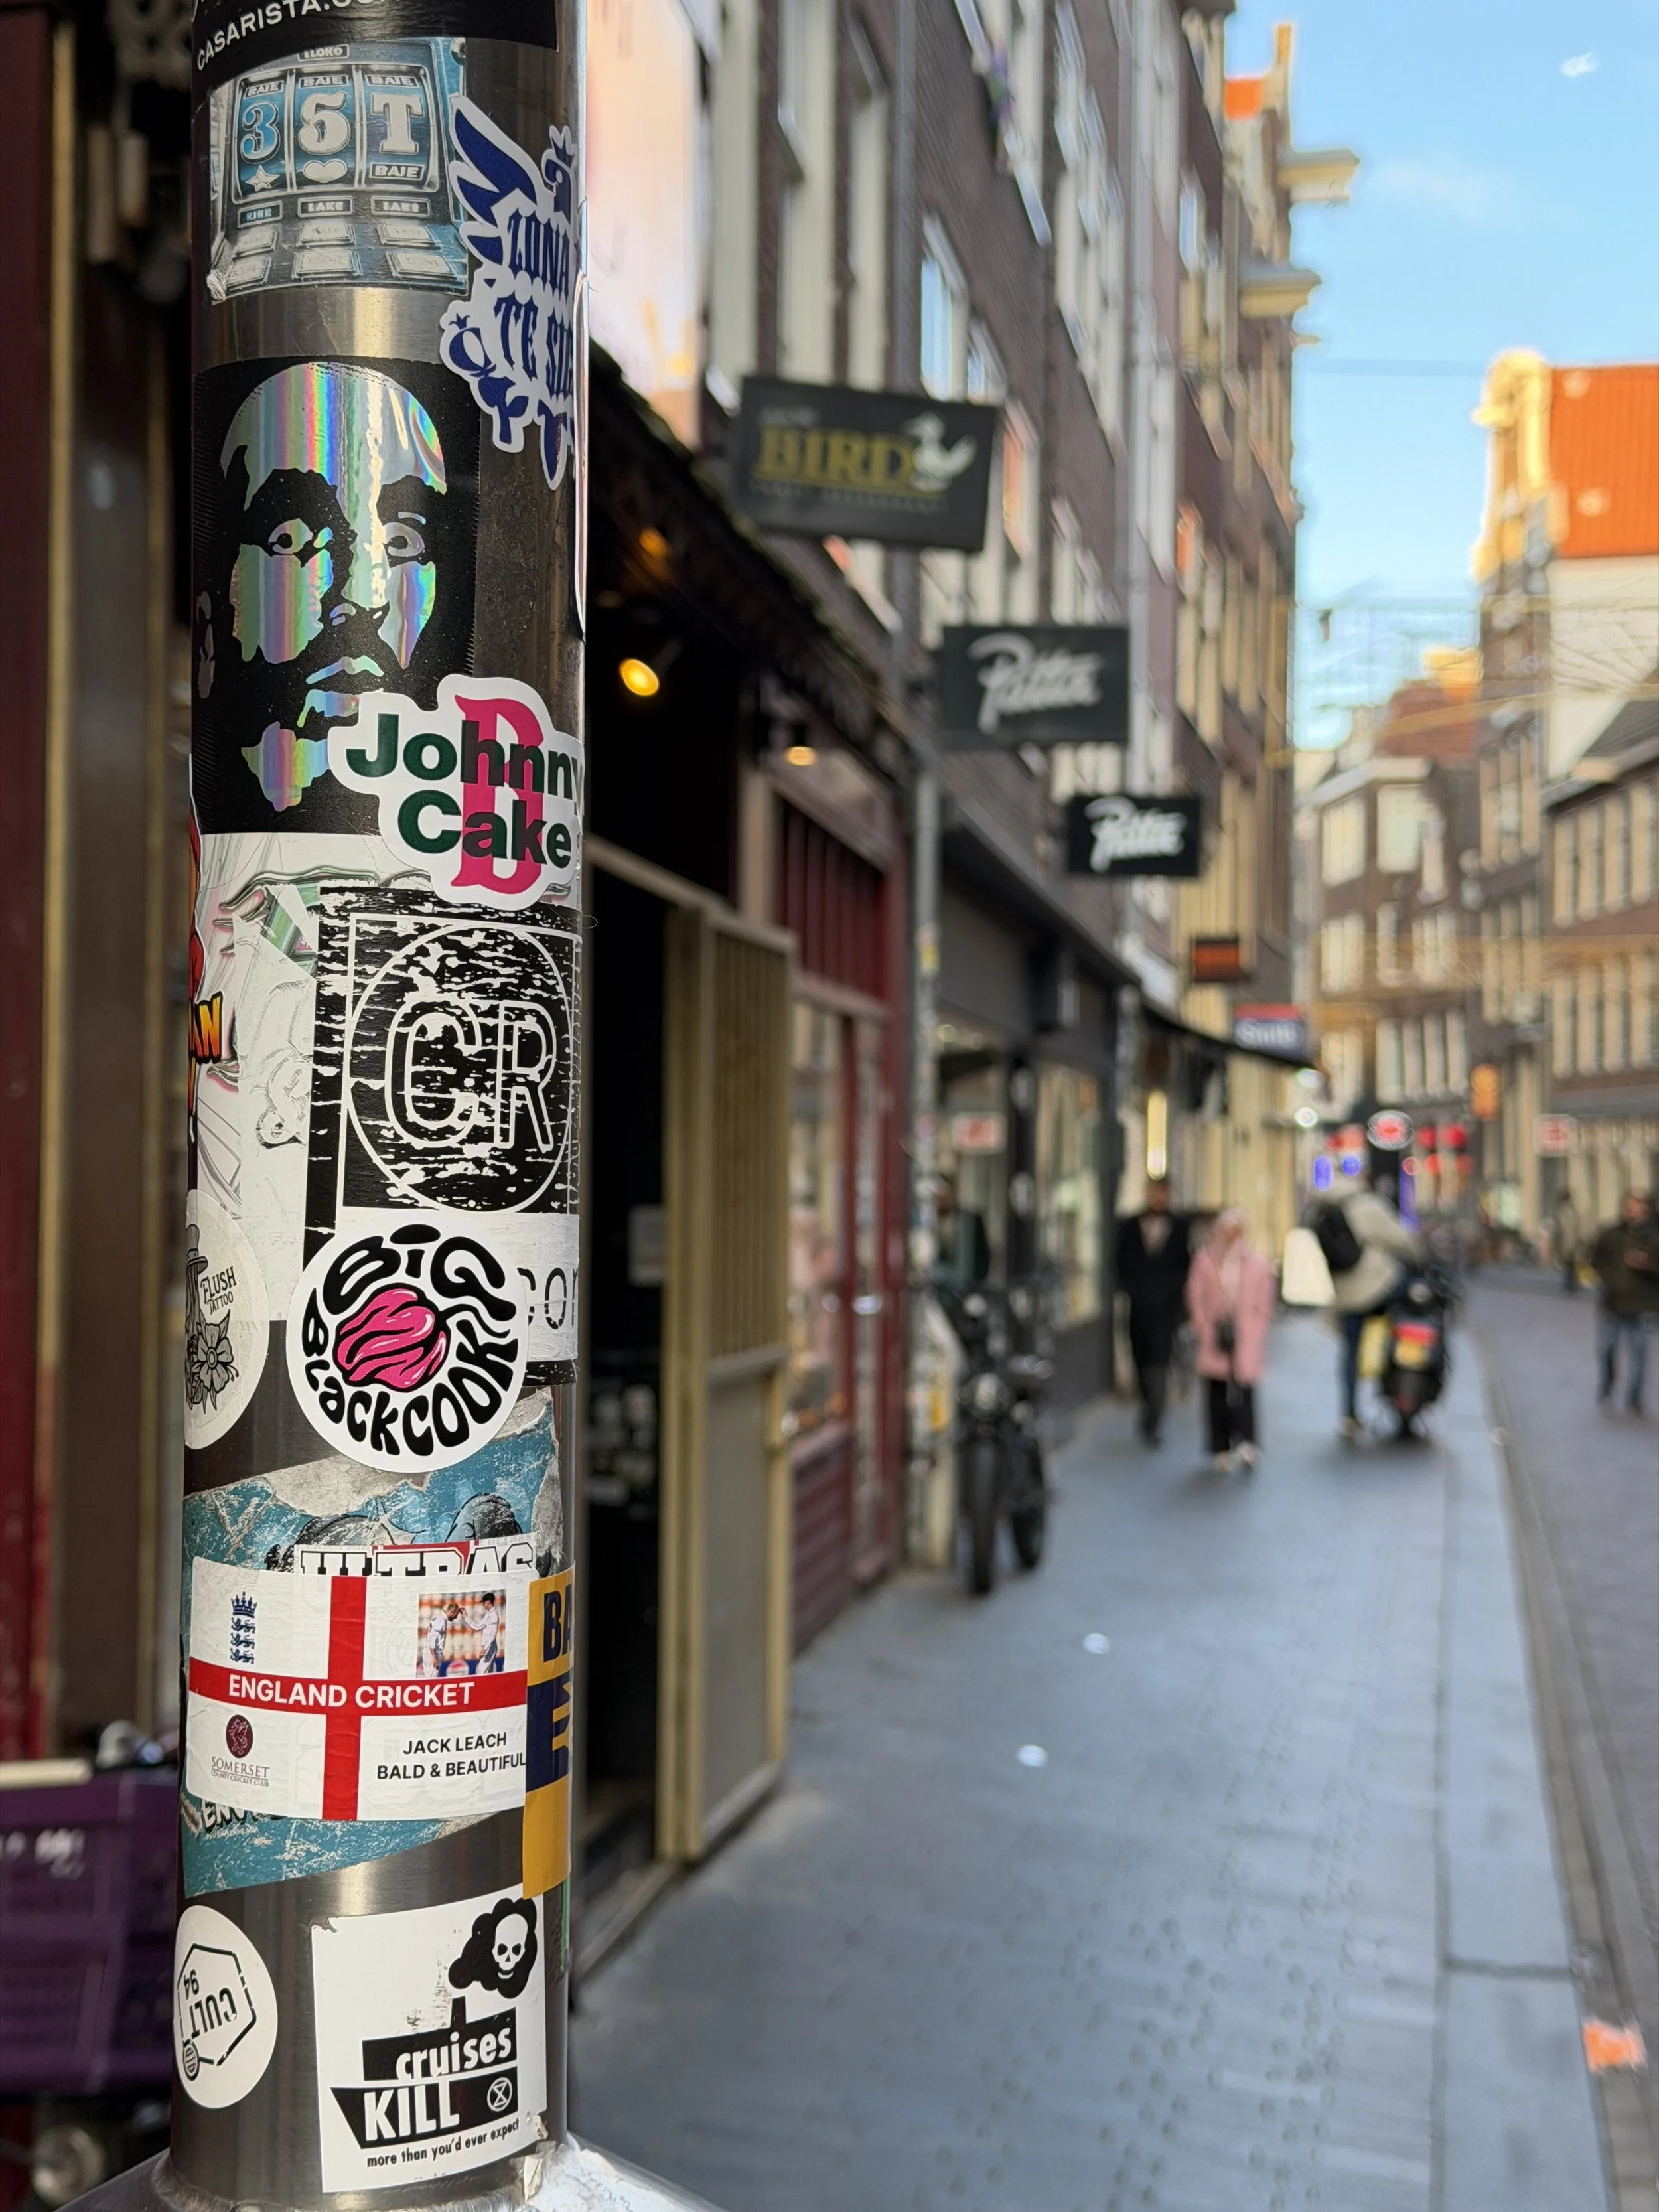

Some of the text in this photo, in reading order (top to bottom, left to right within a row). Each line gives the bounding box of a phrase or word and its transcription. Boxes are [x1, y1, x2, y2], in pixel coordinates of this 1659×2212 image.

[198, 0, 386, 70] CASARISTA.
[757, 425, 918, 490] BIRD
[397, 789, 572, 869] Cake
[200, 1266, 237, 1305] FLUSH
[206, 1291, 234, 1315] TATTOO
[229, 1674, 475, 1708] ENGLAND CRICKET
[403, 1732, 507, 1754] JACK LEACH
[211, 1756, 270, 1778] SOMERSET
[211, 1769, 230, 1780] COUNTY
[230, 1775, 253, 1785] CRICKET
[377, 1752, 527, 1779] BALD & BEAUTIFUL
[189, 1987, 238, 2039] CULT
[396, 2027, 512, 2080] cruises
[364, 2081, 460, 2142] KILL
[367, 2118, 520, 2168] more than you'd ever expect
